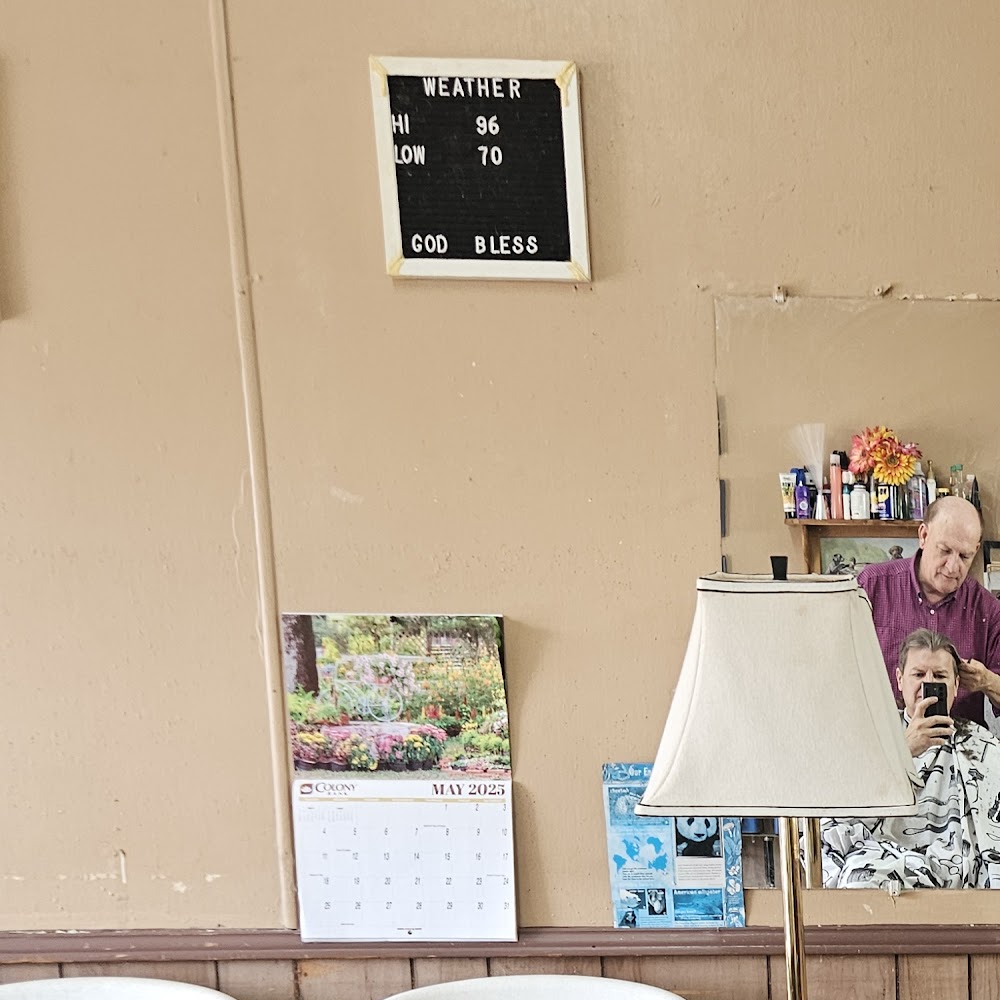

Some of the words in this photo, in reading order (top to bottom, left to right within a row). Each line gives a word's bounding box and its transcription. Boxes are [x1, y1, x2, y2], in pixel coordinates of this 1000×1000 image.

[423, 77, 521, 99] WEATHER
[391, 113, 410, 135] HI
[475, 115, 500, 136] 96
[394, 144, 426, 166] LOW
[477, 145, 503, 166] 70
[411, 233, 448, 254] GOD
[474, 235, 538, 255] BLESS
[315, 782, 356, 793] COLONY
[432, 784, 465, 796] MAY
[468, 783, 506, 796] 2025
